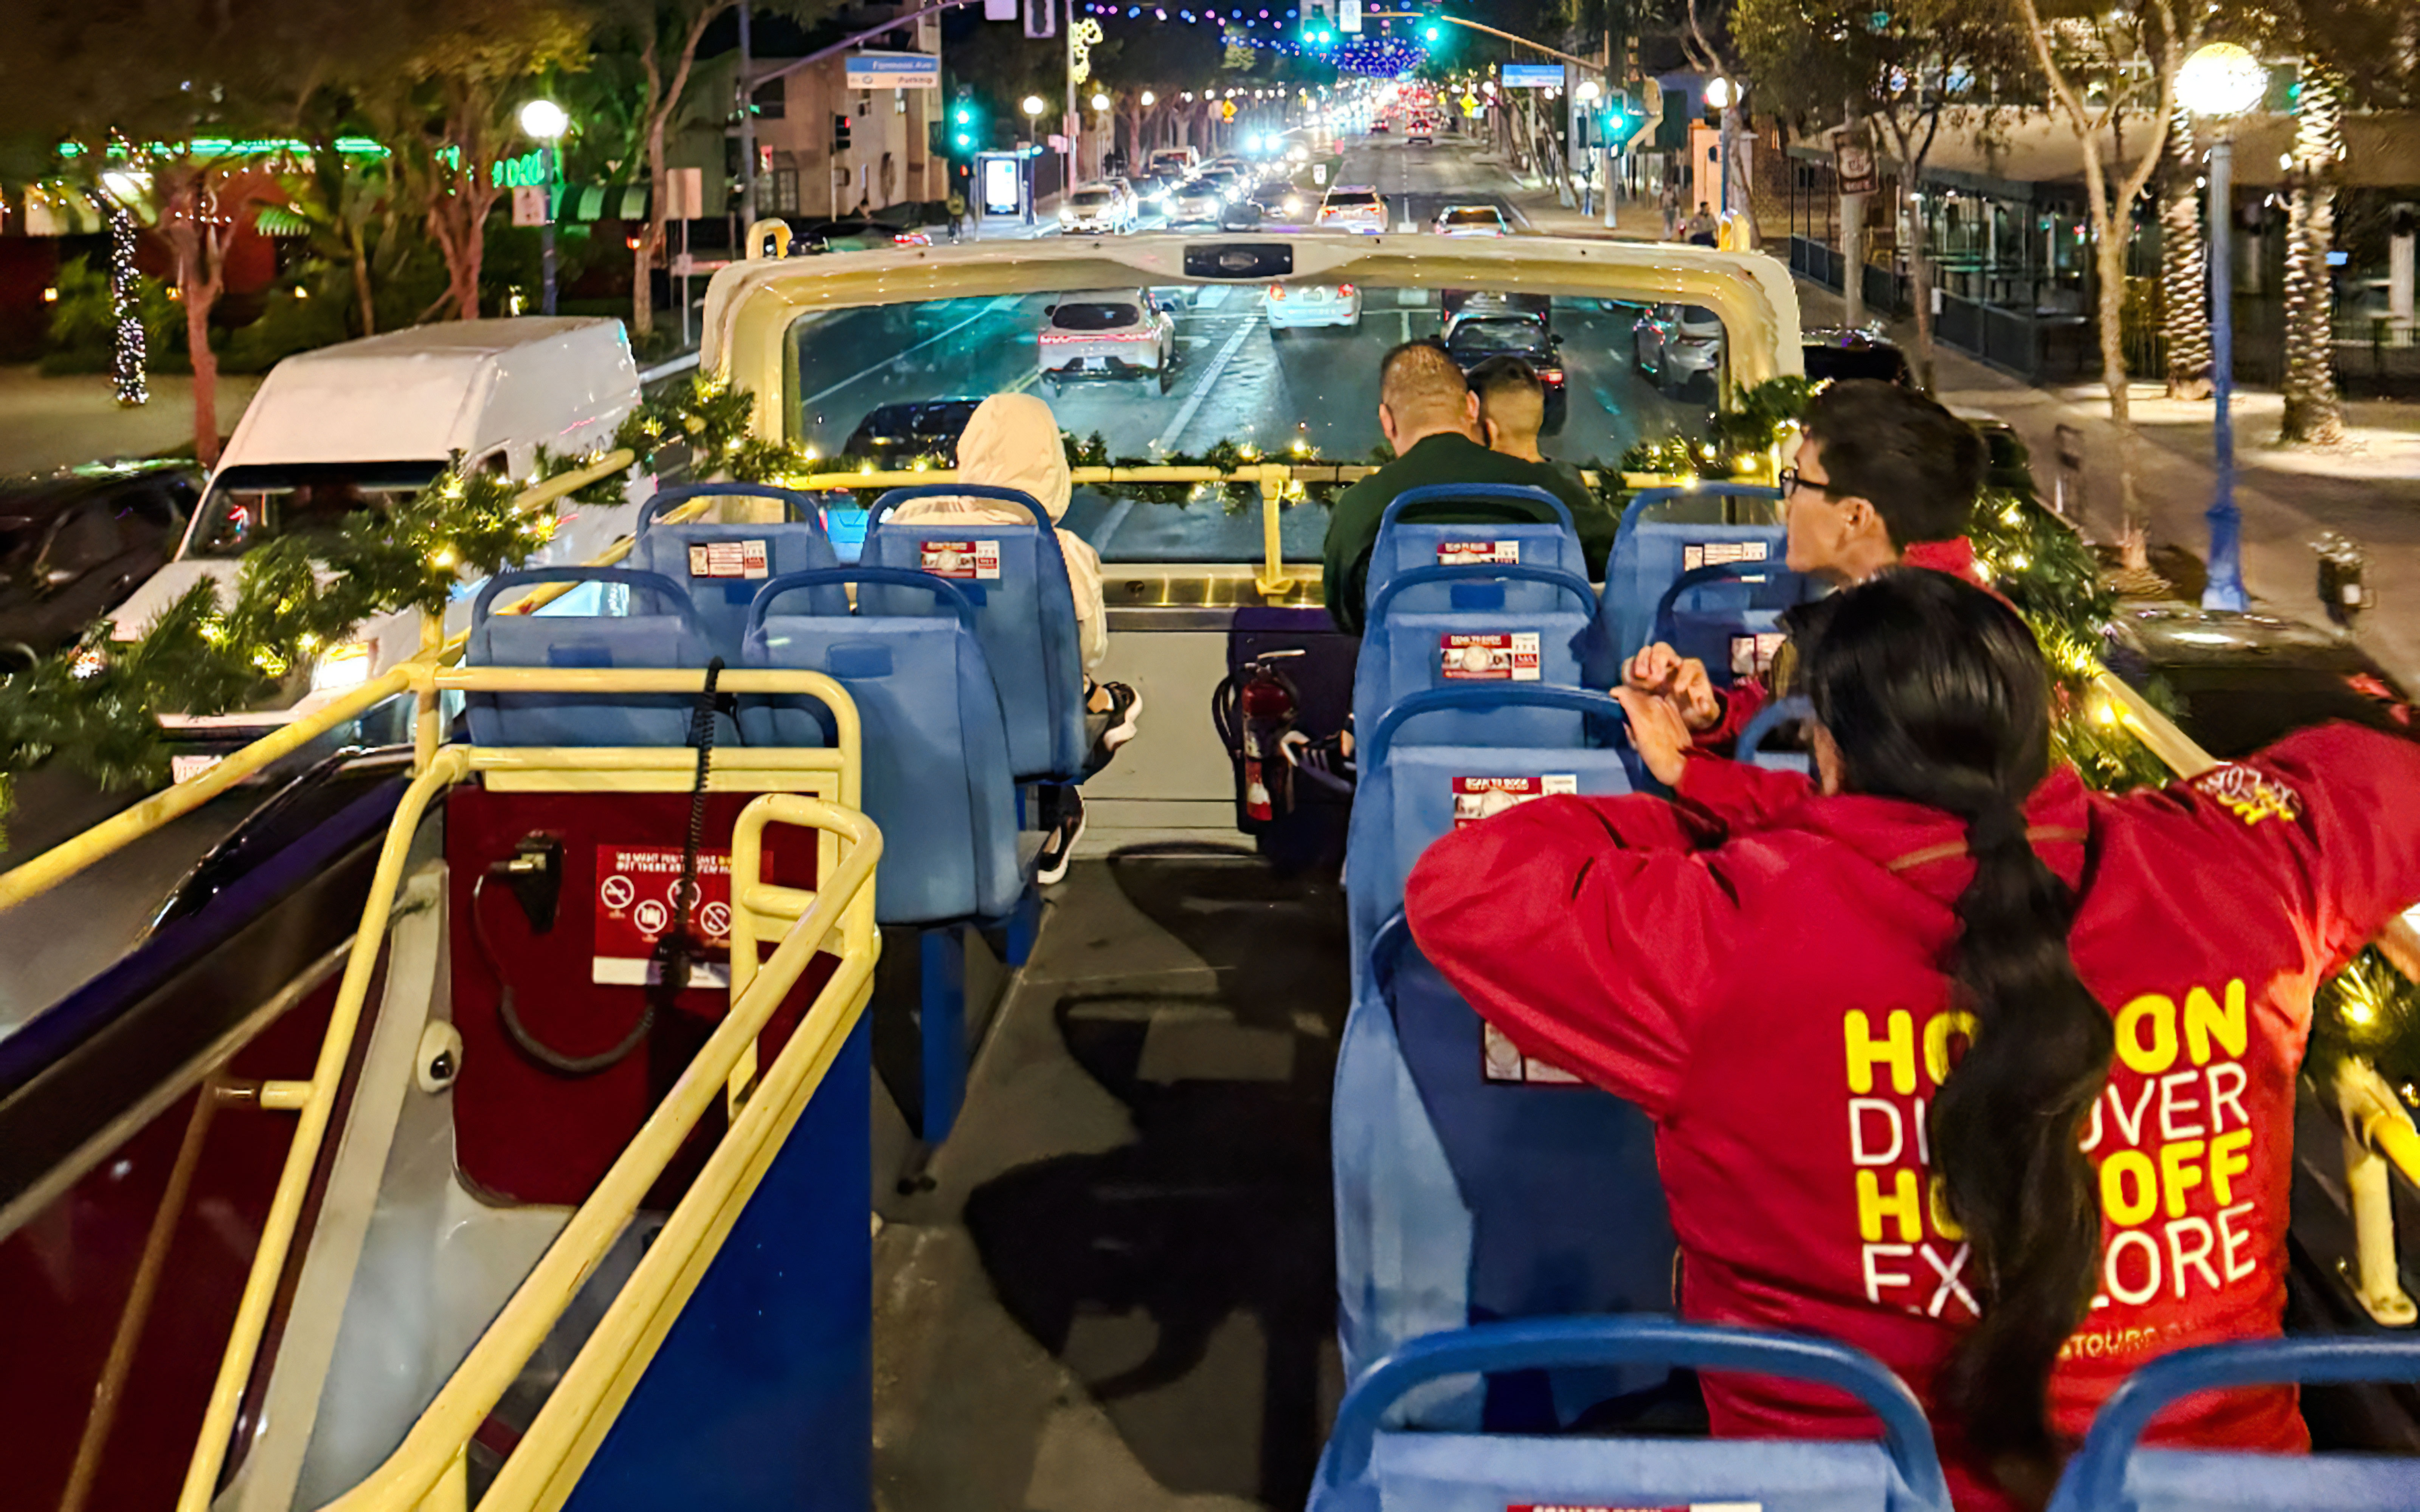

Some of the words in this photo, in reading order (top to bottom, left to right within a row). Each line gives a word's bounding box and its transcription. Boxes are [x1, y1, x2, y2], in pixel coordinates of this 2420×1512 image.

[1844, 1009, 1981, 1095] HO
[2114, 978, 2248, 1074] ON
[2099, 1128, 2252, 1227] OFF
